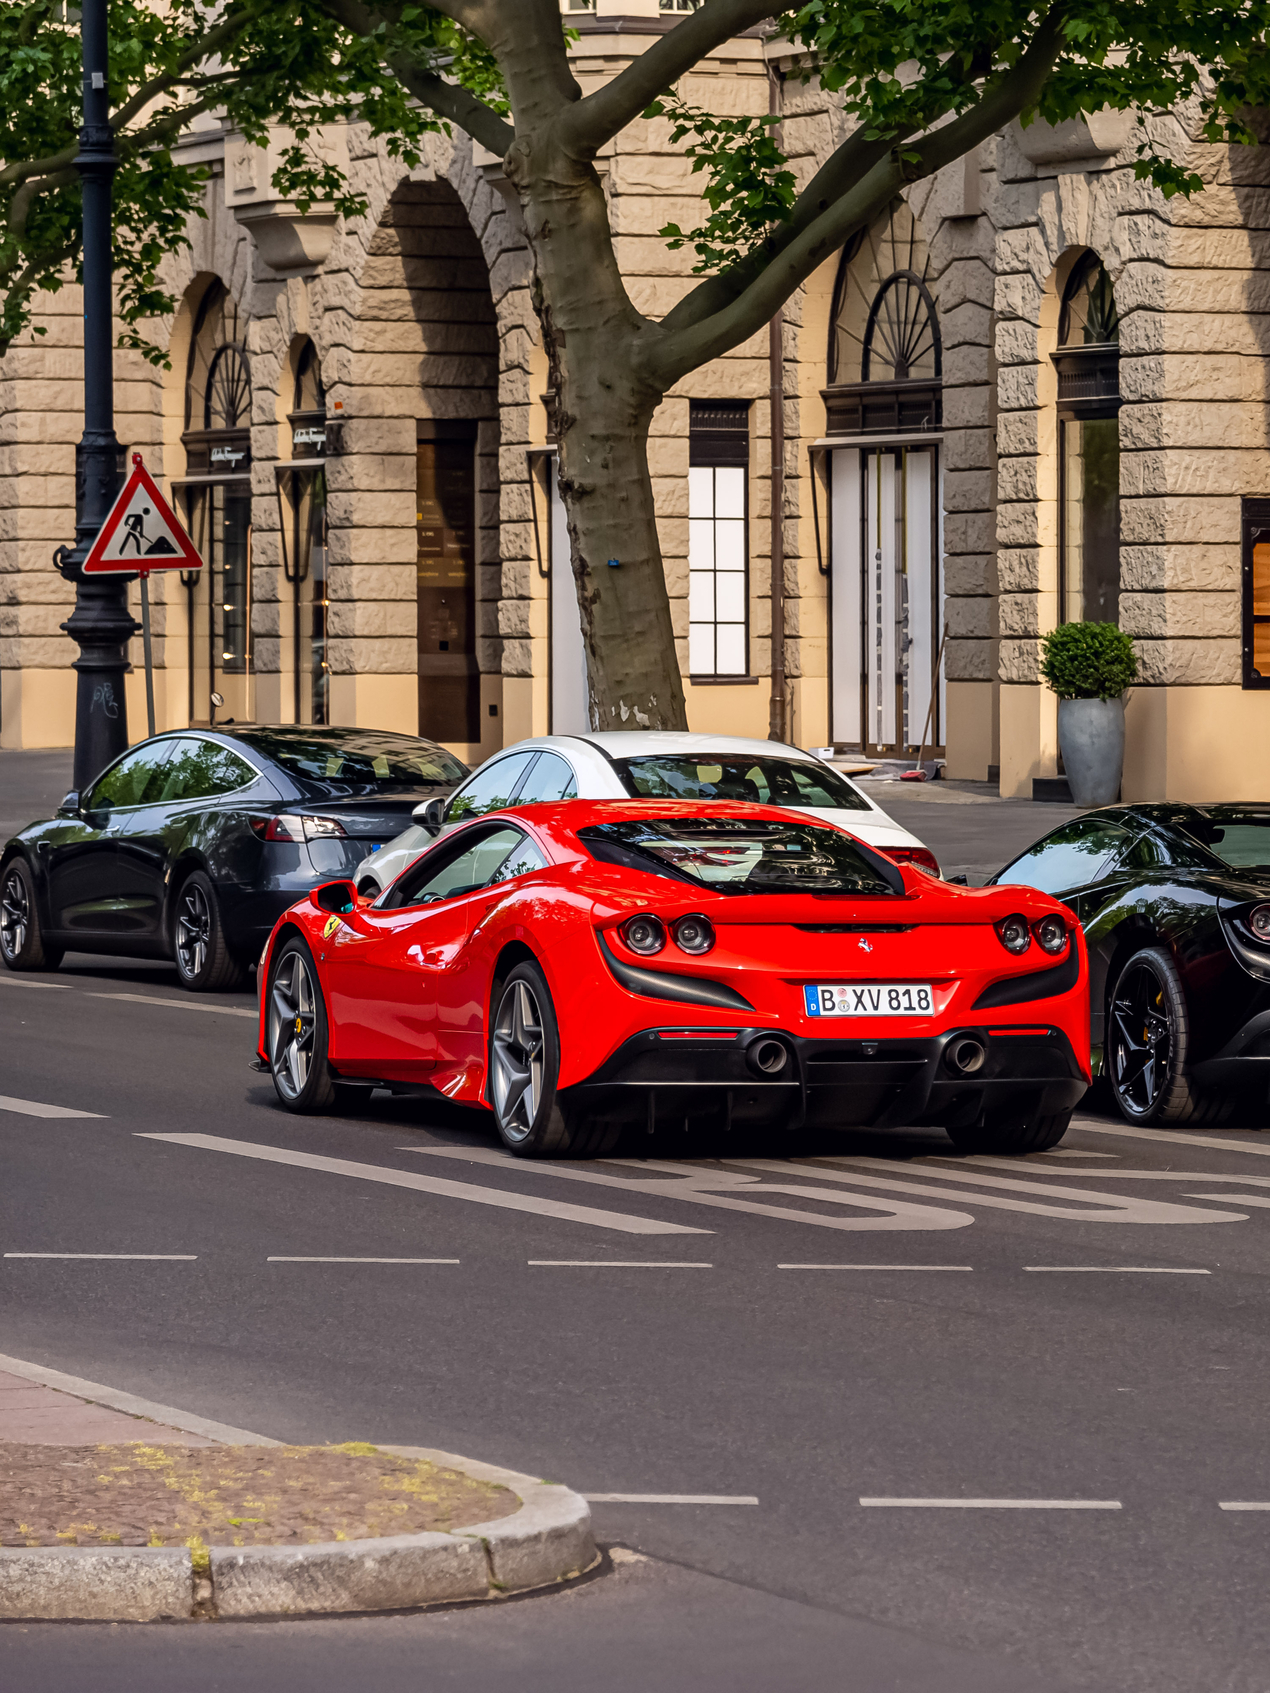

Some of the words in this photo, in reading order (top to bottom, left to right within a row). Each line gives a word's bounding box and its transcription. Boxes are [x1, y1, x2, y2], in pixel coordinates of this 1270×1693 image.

[810, 1003, 817, 1011] D
[820, 989, 836, 1011] B
[852, 989, 881, 1011] XV
[888, 988, 930, 1011] 818
